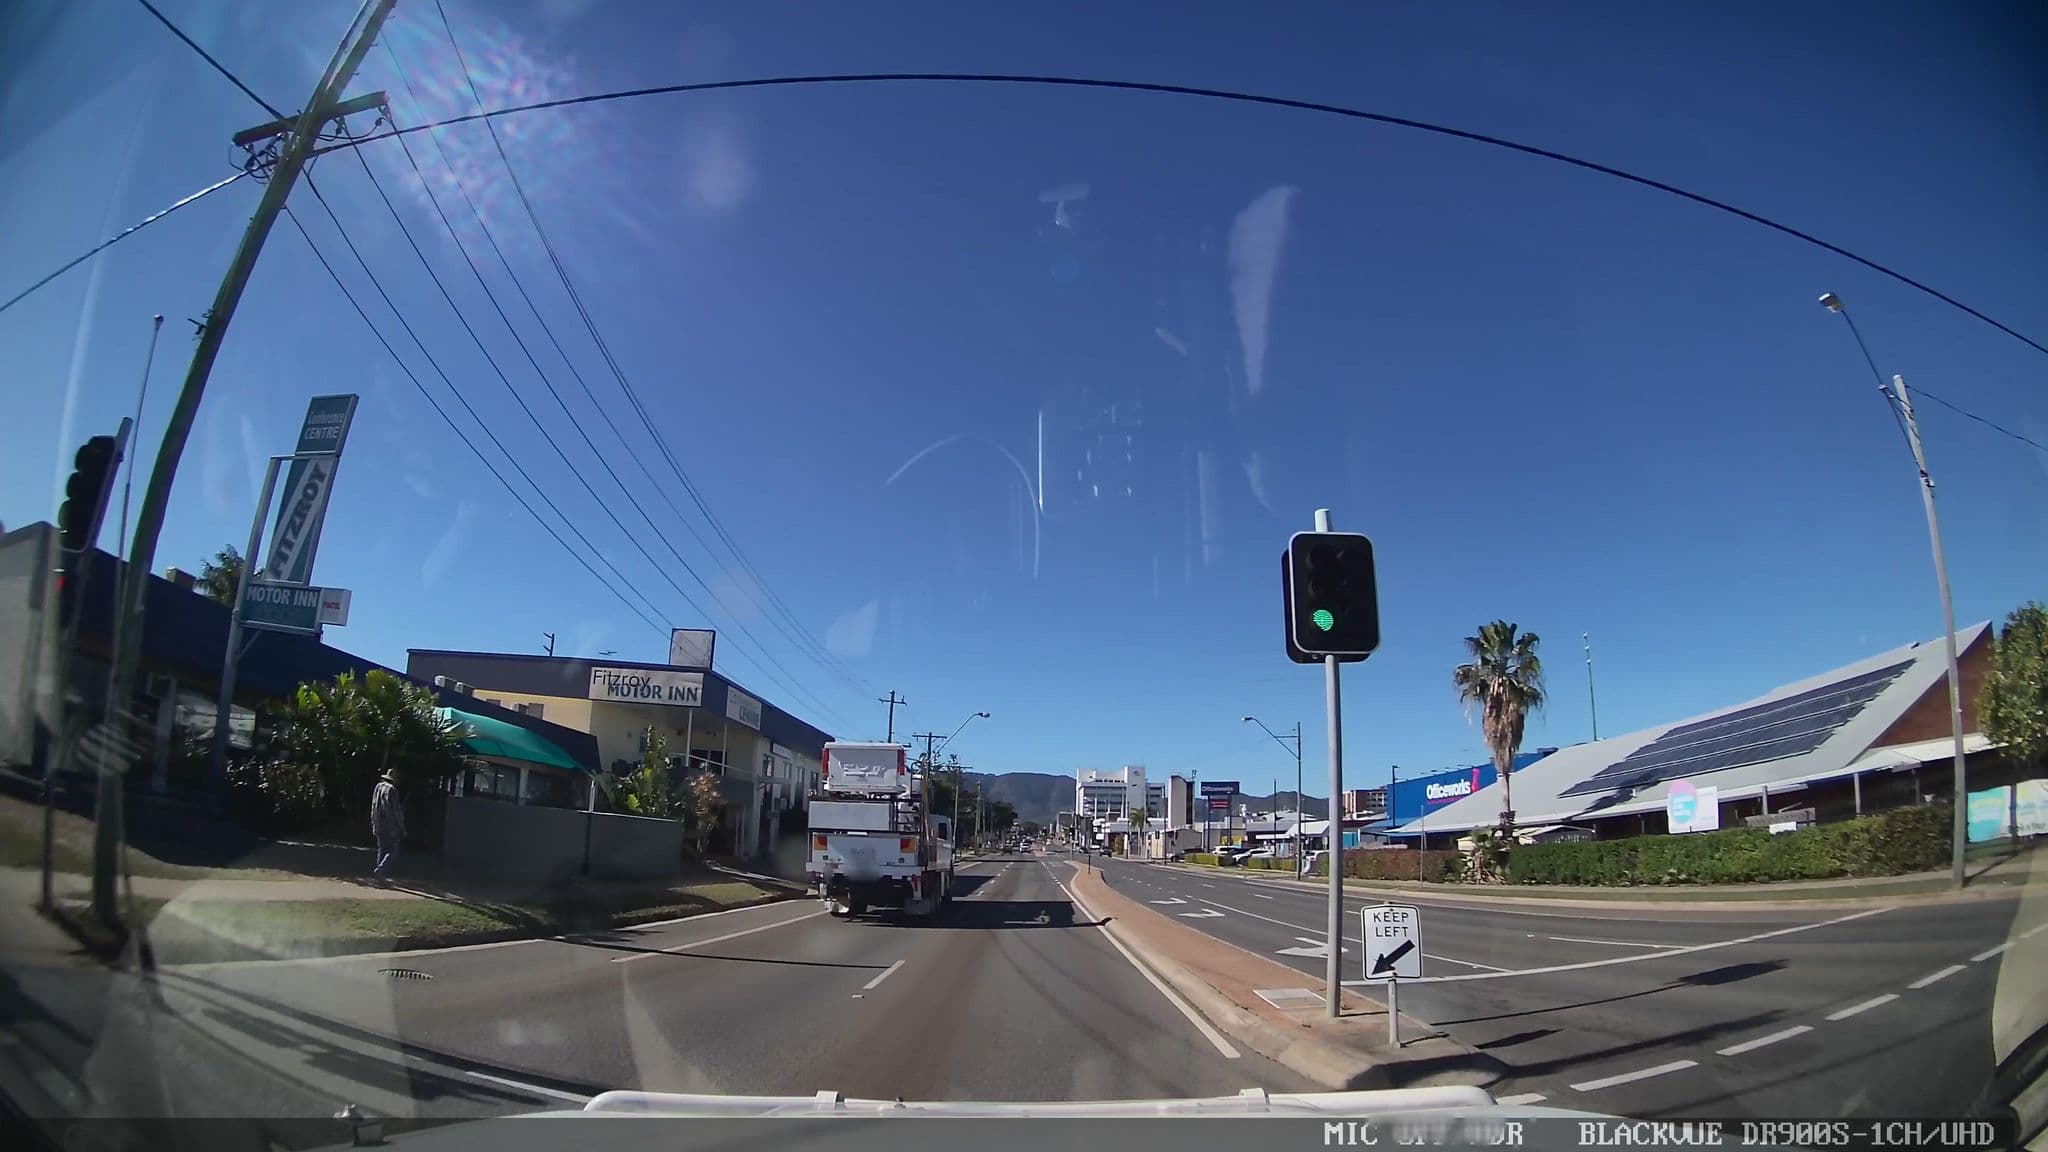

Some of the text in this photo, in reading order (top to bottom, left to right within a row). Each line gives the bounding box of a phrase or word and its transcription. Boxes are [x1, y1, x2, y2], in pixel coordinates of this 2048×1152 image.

[304, 426, 341, 440] CENTRE
[269, 461, 328, 579] FITZROY
[246, 586, 290, 605] MOTOR
[293, 590, 319, 608] INN
[592, 669, 651, 690] Fitzroy
[607, 684, 699, 702] MOTOR INN
[1426, 779, 1471, 800] Officeworks
[1373, 911, 1409, 923] KEEP
[1375, 926, 1409, 938] LEFT
